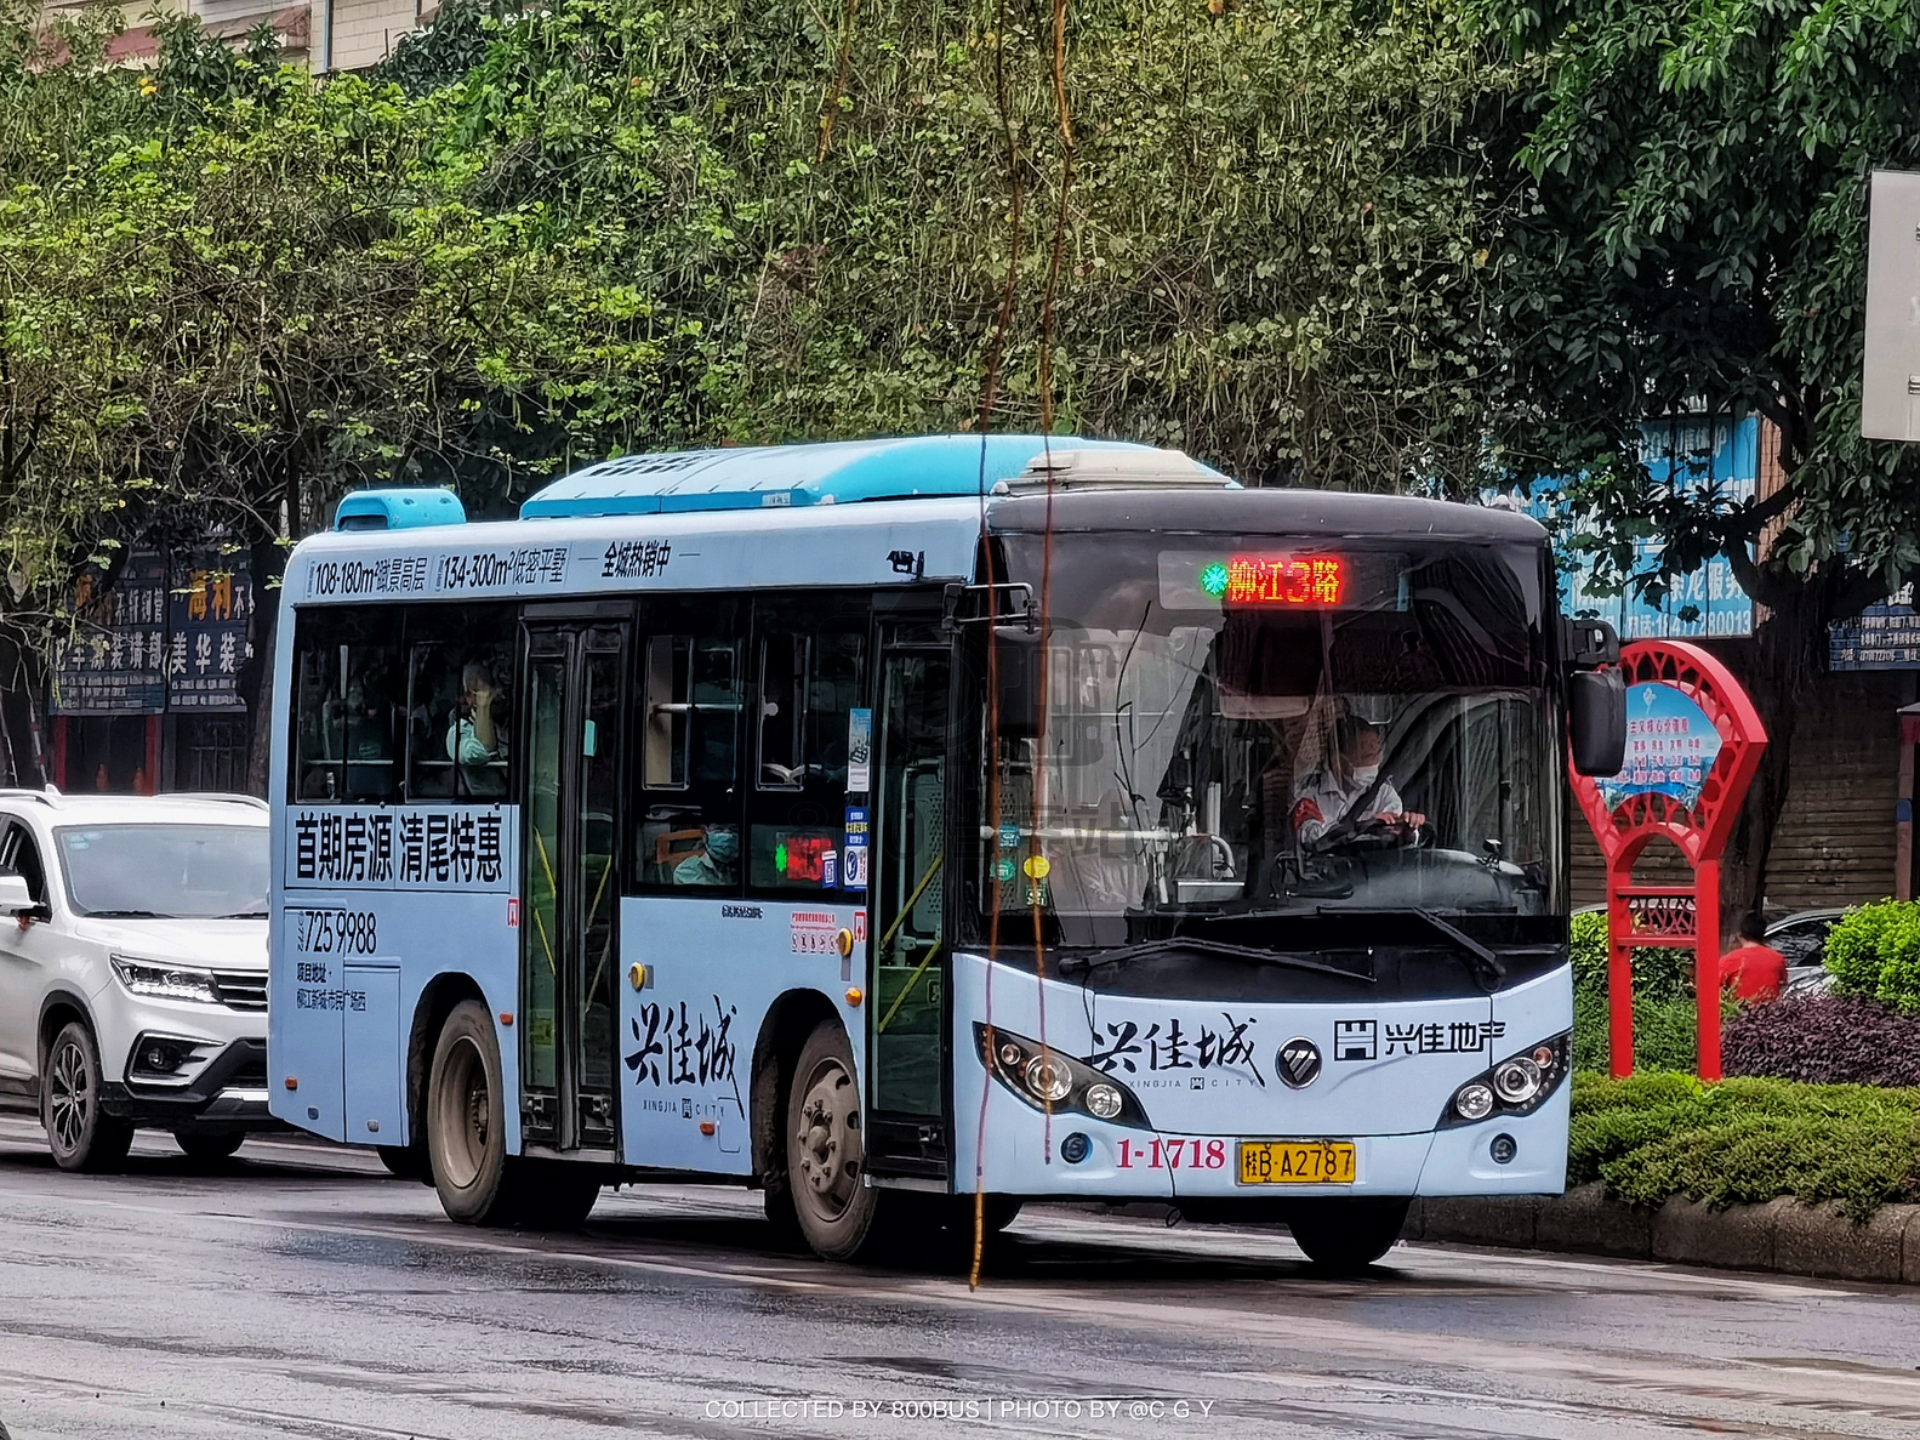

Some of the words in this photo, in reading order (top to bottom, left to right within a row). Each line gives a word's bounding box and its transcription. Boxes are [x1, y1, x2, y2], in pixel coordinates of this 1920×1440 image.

[601, 539, 672, 578] 全城热销中
[295, 811, 393, 882] 首期房源
[399, 811, 503, 884] 清尾特惠
[1081, 1012, 1266, 1088] 兴佳城
[1385, 1021, 1506, 1056] 兴佳地产
[624, 994, 746, 1121] 兴佳城
[1128, 1079, 1182, 1088] XINGJIA
[642, 1099, 678, 1114] XINGJIA
[1116, 1138, 1226, 1170] 1-1718
